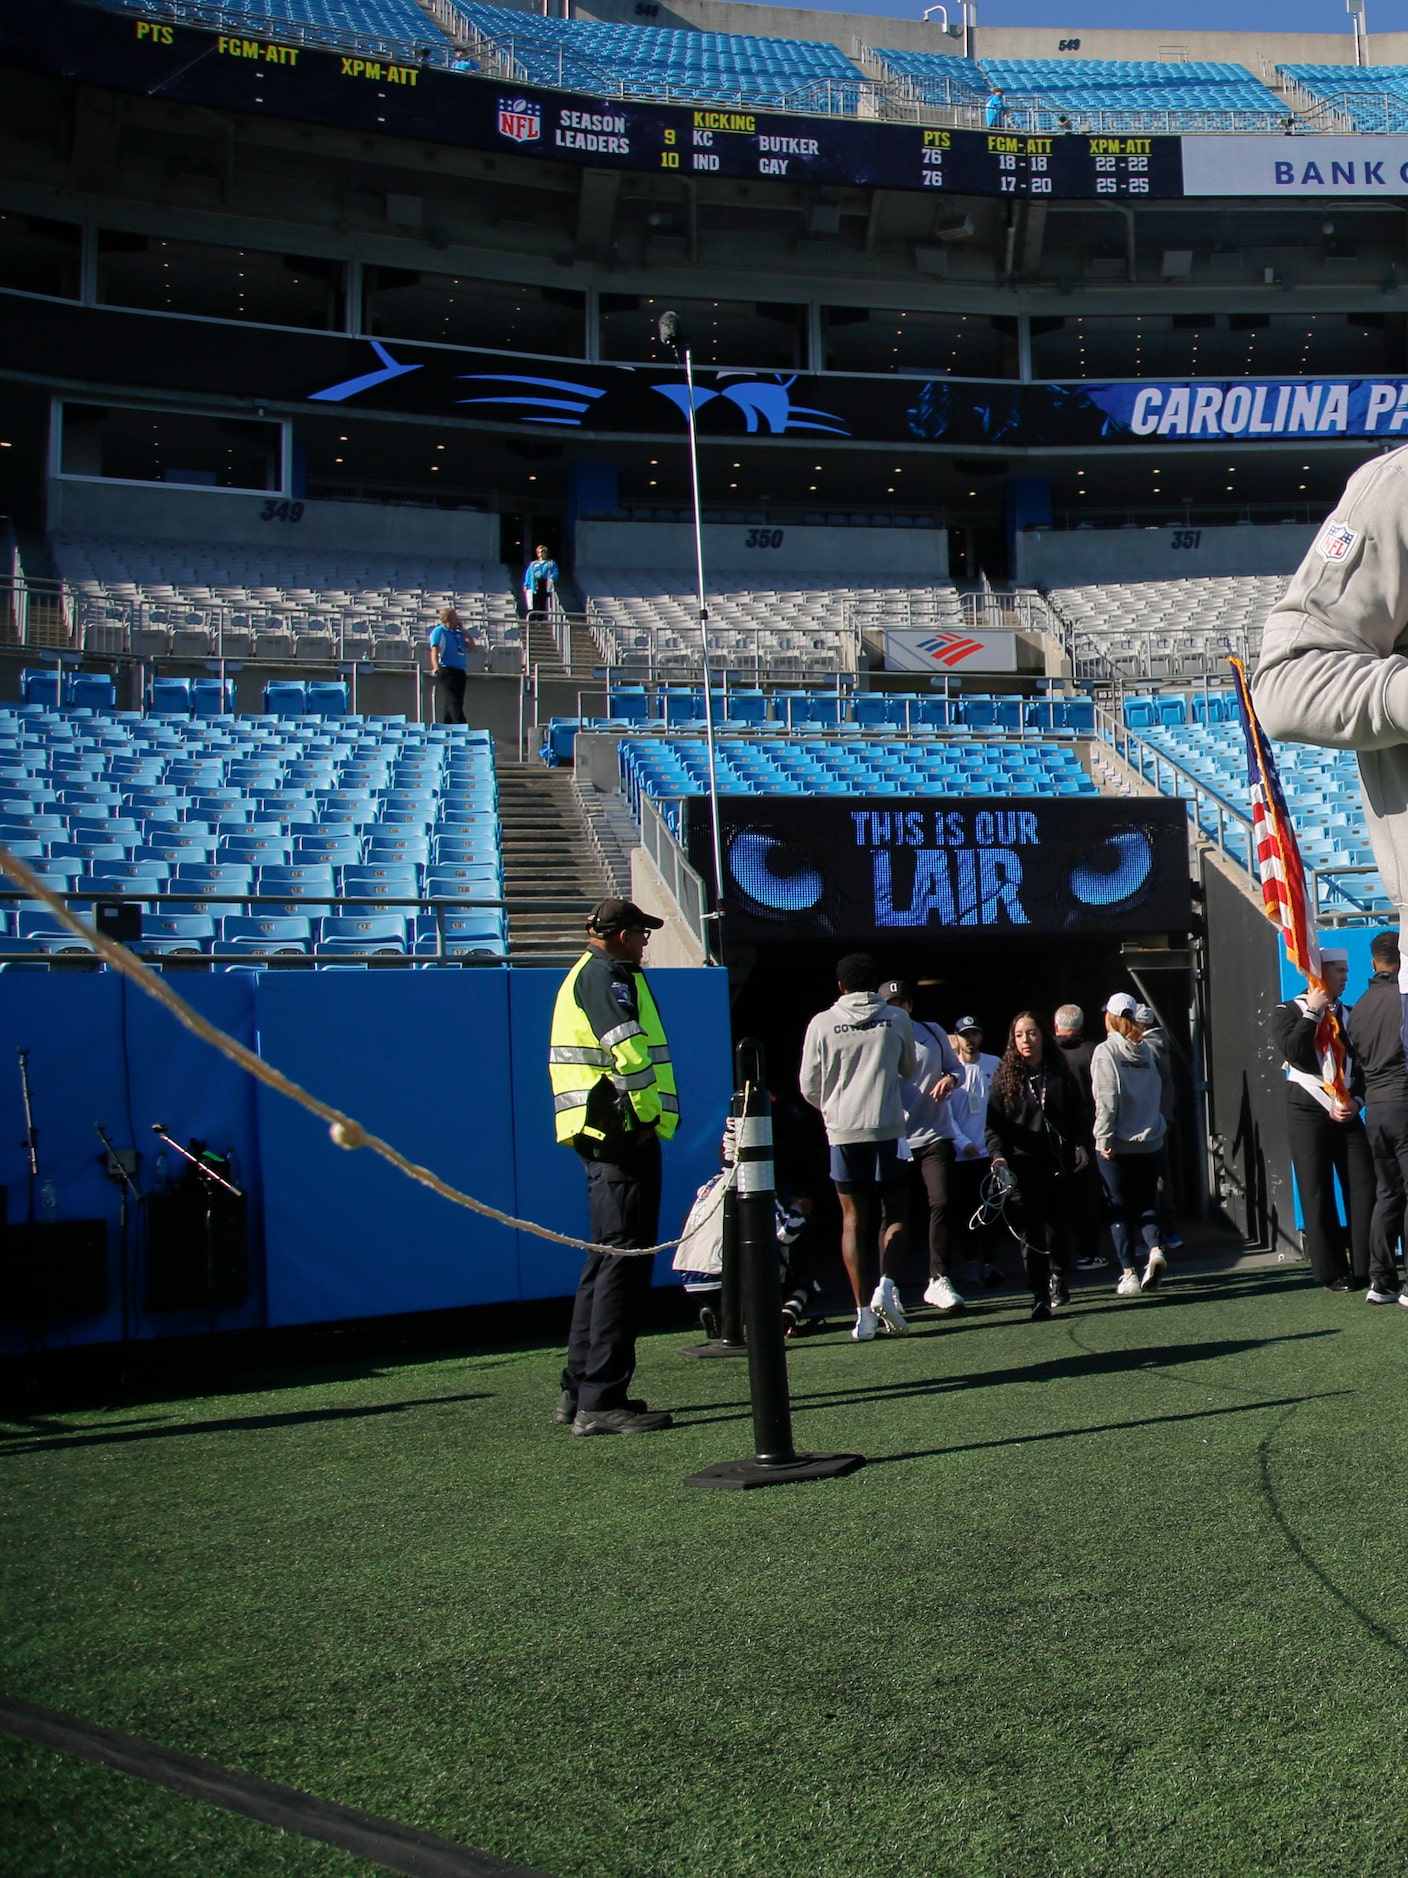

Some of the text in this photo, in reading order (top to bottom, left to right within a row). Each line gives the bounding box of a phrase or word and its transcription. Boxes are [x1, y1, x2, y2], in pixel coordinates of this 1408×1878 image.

[136, 21, 174, 45] PTS
[1058, 38, 1081, 51] 549
[218, 35, 299, 66] FGM-ATT
[341, 57, 419, 86] XPM-ATT
[500, 112, 541, 141] NFL
[560, 109, 626, 134] SEASON
[694, 111, 756, 132] KICKING
[555, 129, 630, 155] LEADERS
[664, 129, 675, 145] 9
[693, 130, 714, 147] KC
[759, 135, 819, 156] BUTKER
[921, 148, 942, 164] 76
[999, 155, 1016, 170] 18
[1031, 156, 1048, 171] 18
[923, 131, 951, 147] PTS
[987, 135, 1053, 153] FGM-ATT
[1089, 138, 1152, 154] XPM-ATT
[660, 151, 680, 168] 10
[693, 153, 720, 171] IND
[759, 157, 790, 175] GAY
[921, 170, 943, 186] 76
[1000, 176, 1016, 192] 17
[1031, 178, 1052, 193] 20
[1275, 161, 1387, 186] BANK
[1131, 383, 1350, 436] CAROLINA
[261, 499, 305, 523] 349
[745, 528, 785, 549] 350
[1171, 529, 1202, 550] 351
[1323, 535, 1345, 557] NFL
[850, 811, 1041, 847] THIS IS OUR
[869, 848, 1033, 927] LAIR
